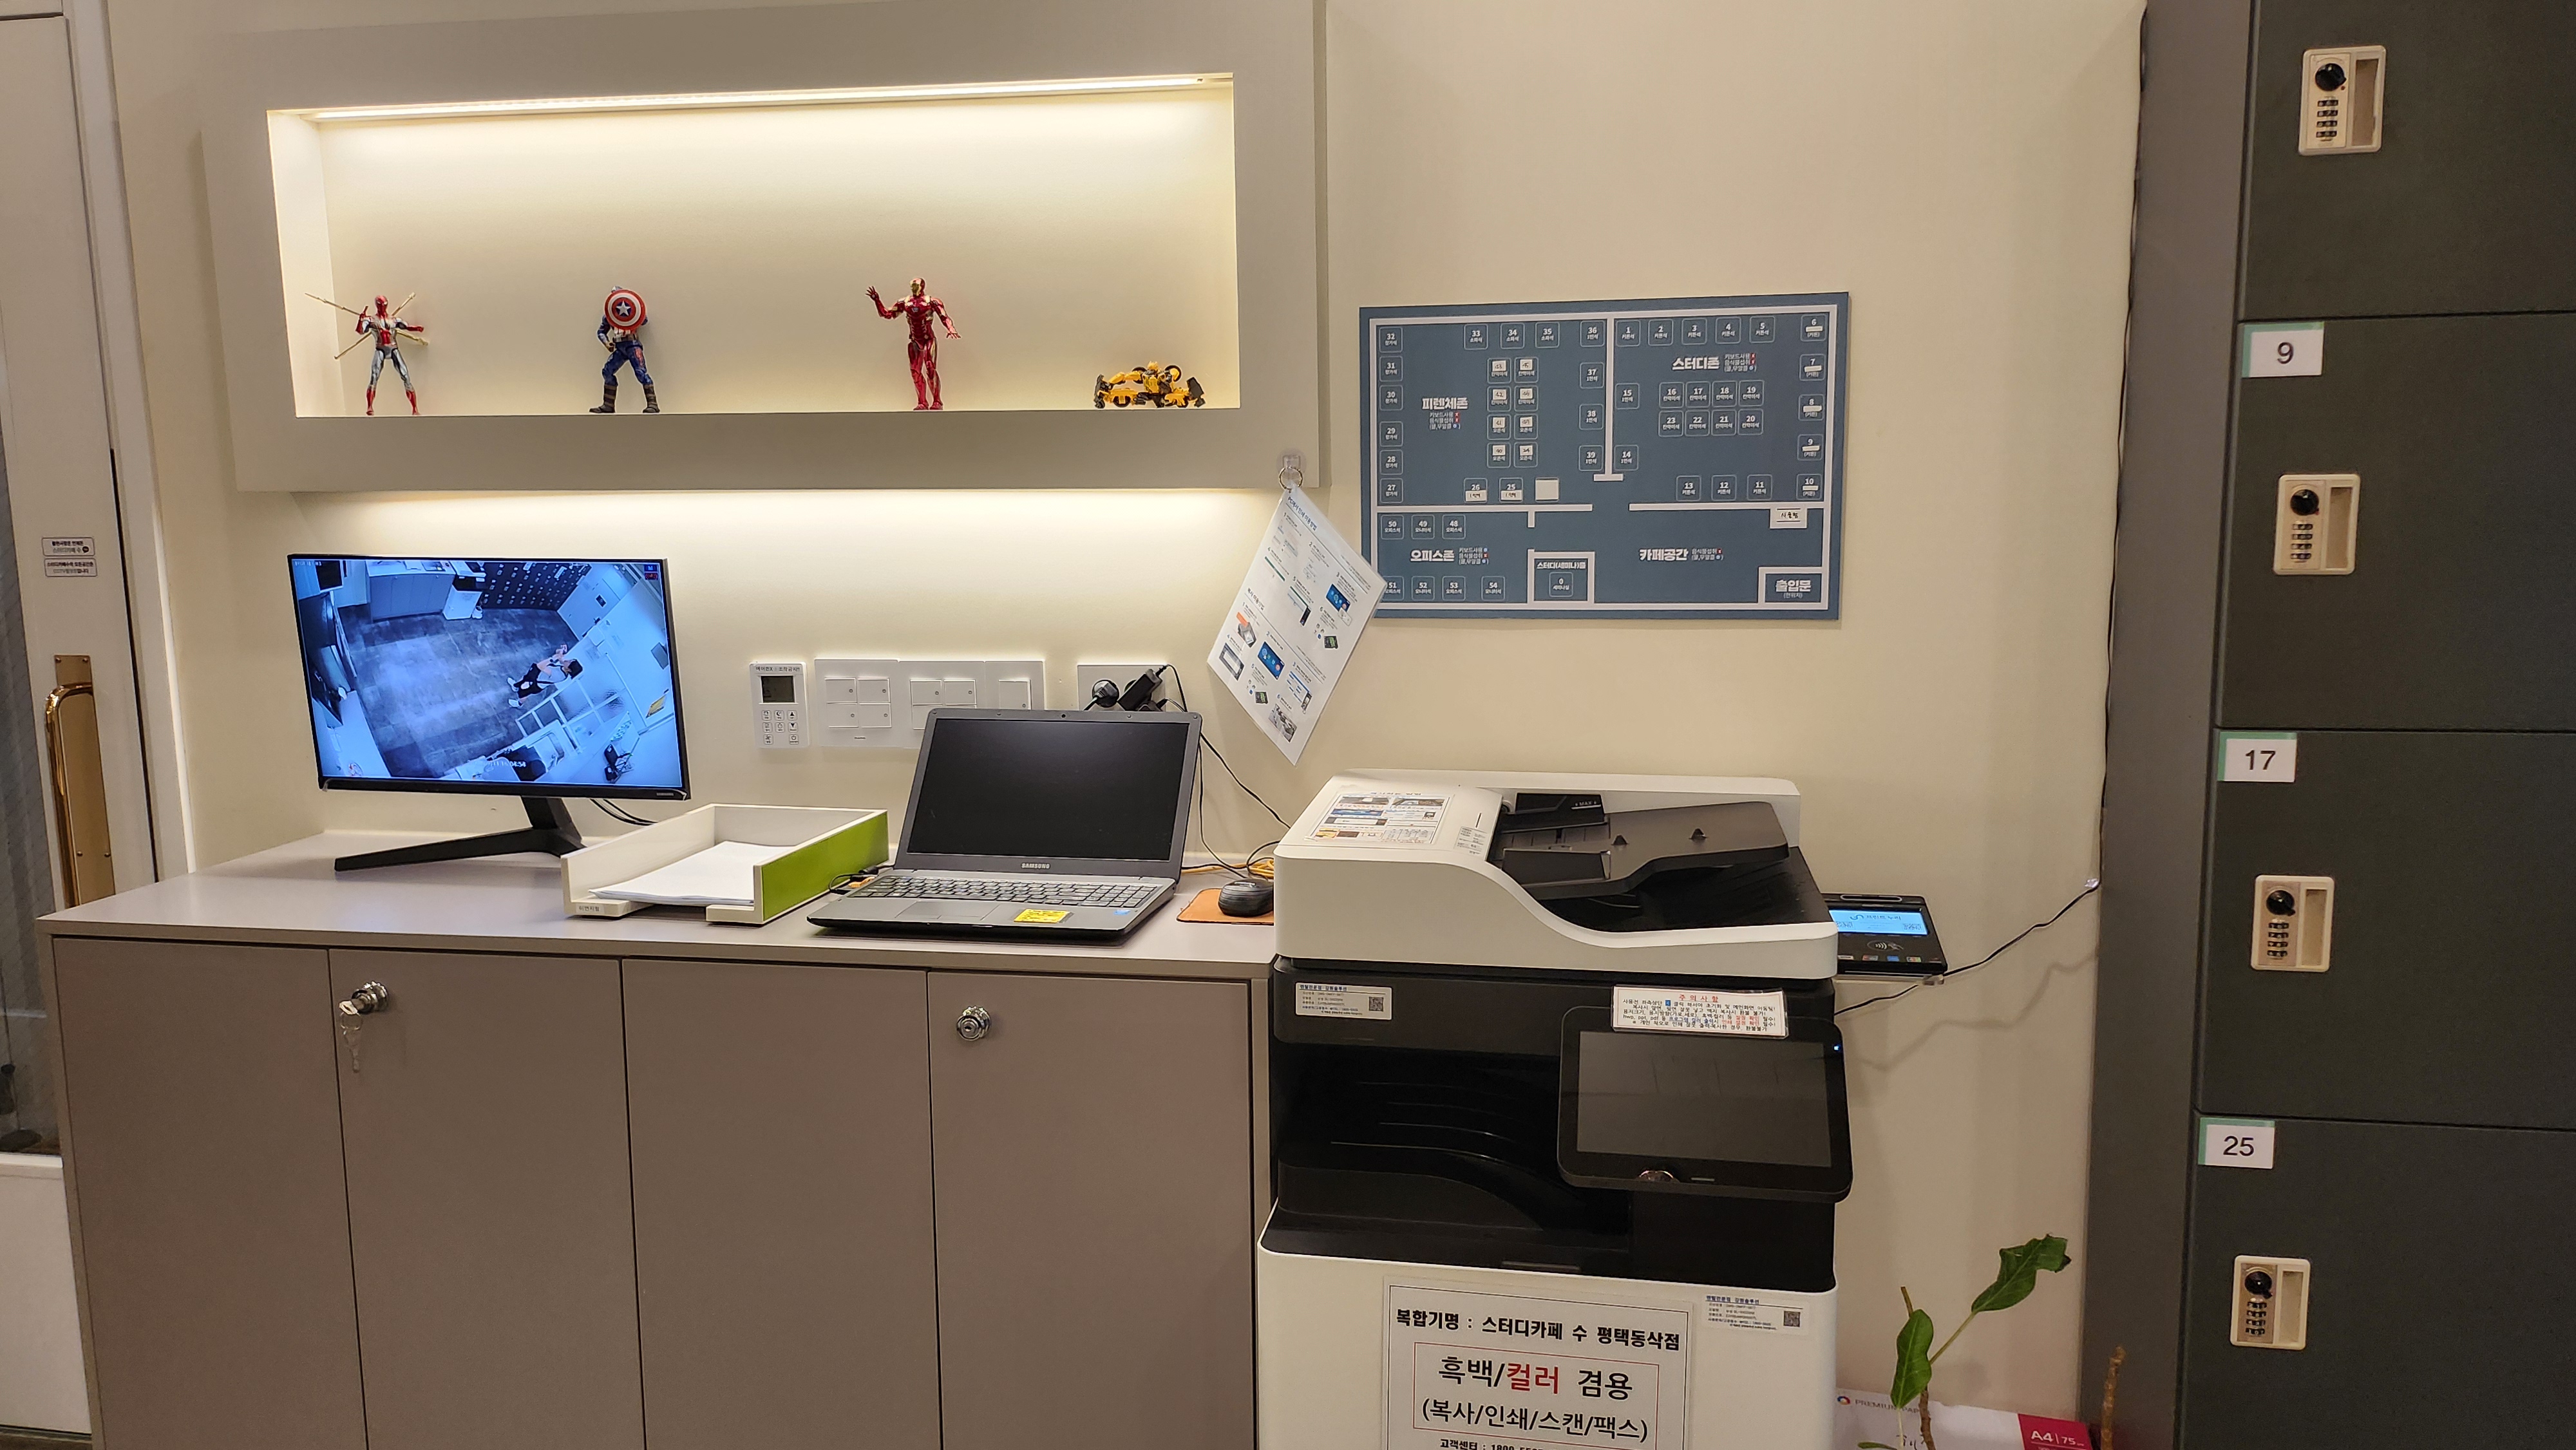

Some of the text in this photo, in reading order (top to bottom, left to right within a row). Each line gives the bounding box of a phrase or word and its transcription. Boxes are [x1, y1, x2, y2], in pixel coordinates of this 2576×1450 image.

[2277, 342, 2294, 364] 9
[1672, 357, 1719, 370] 스터디존
[1423, 397, 1468, 410] 피렌체존
[1410, 550, 1454, 561] 오피스존
[1640, 549, 1689, 561] 카페공간
[1776, 579, 1811, 592] 출입문
[2245, 750, 2276, 771] 17
[2223, 1136, 2254, 1156] 25
[1397, 1309, 1680, 1351] 복합기명 스터디카페 수 평택동삭점
[1439, 1356, 1633, 1400] 흑백/컬러 겸용
[1422, 1398, 1649, 1443] (복사/인쇄/스캔/팩스)
[1440, 1438, 1477, 1450] 고객센터
[2031, 1431, 2076, 1445] A4 75
